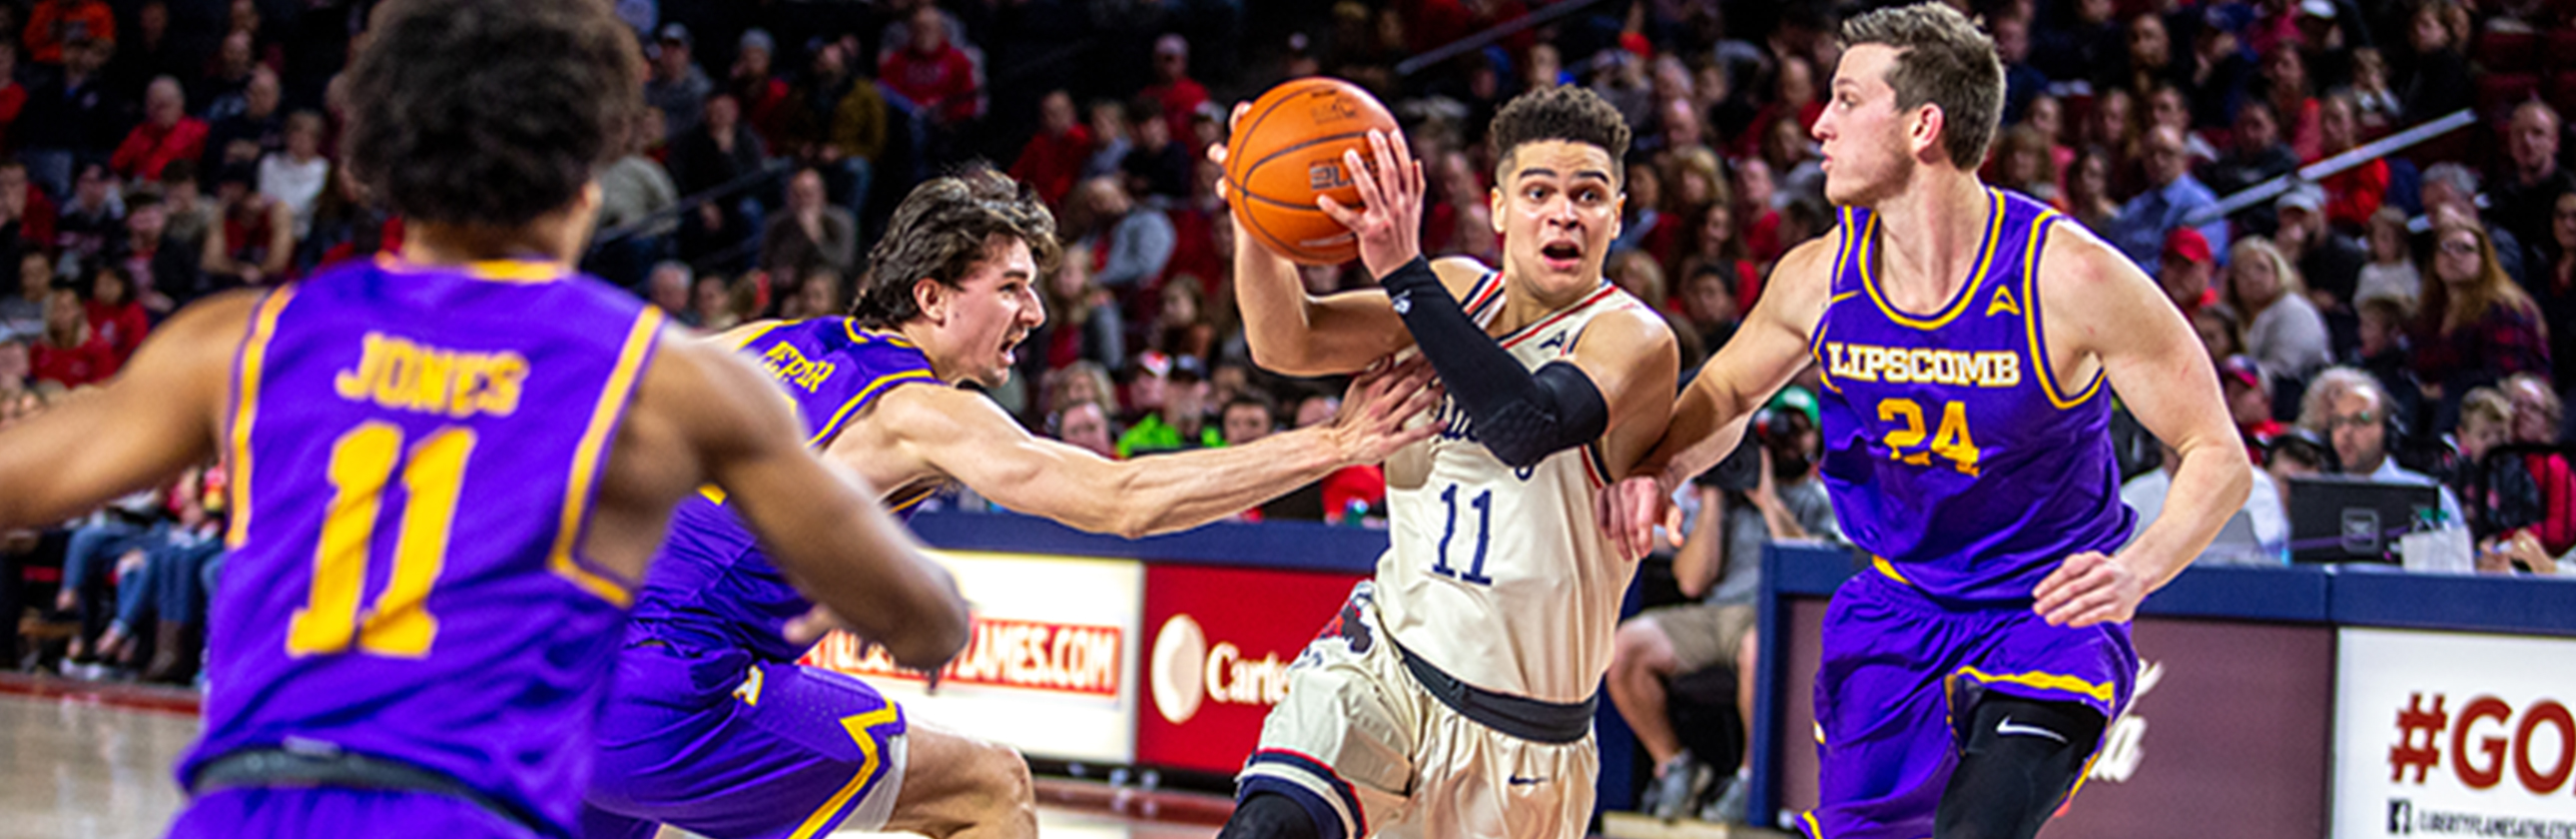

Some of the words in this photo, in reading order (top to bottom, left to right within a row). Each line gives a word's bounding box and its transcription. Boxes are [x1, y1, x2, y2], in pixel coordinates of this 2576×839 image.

[334, 332, 530, 417] JONES
[1826, 342, 2021, 387] LIPSCOMB
[1877, 399, 1980, 476] 24
[286, 420, 477, 658] 11
[1432, 483, 1492, 586] 11
